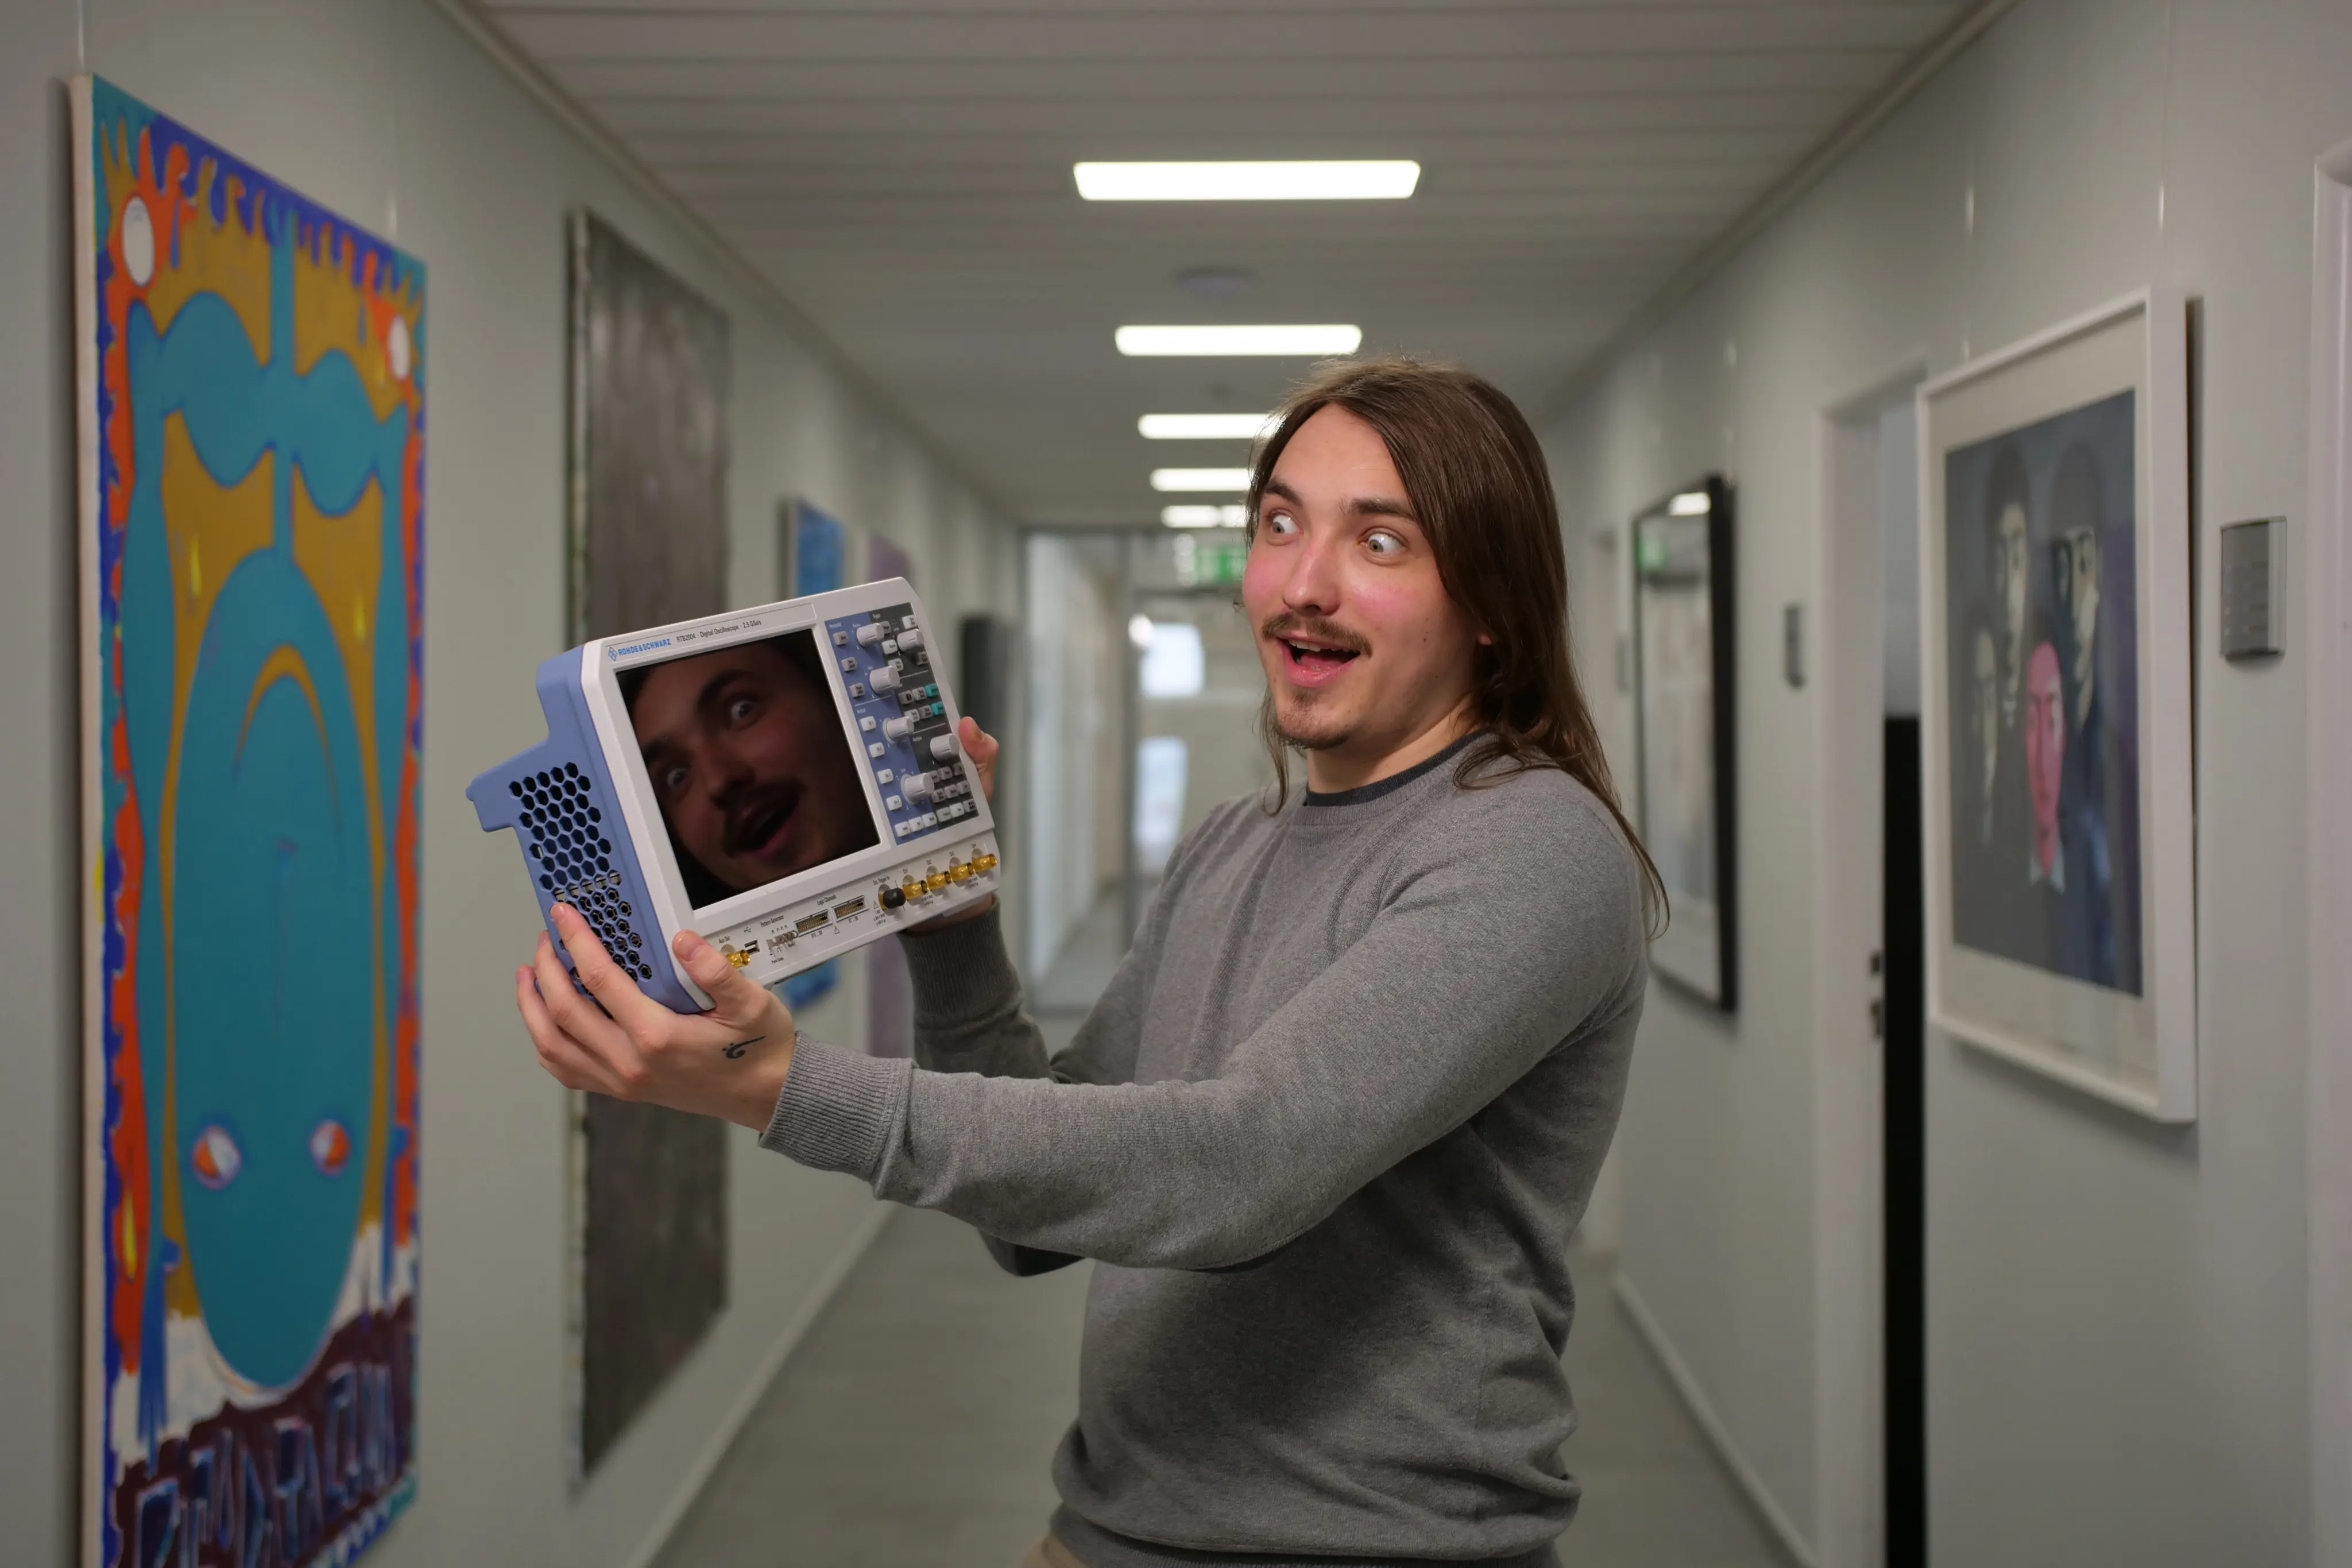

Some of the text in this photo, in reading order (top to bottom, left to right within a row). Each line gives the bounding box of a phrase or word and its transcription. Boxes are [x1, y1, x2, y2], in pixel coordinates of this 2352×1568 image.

[676, 633, 696, 642] RTB2004
[699, 629, 714, 638] Digital
[714, 625, 740, 634] Oscilloscope
[617, 638, 671, 656] ROHDE&SCHWARZ
